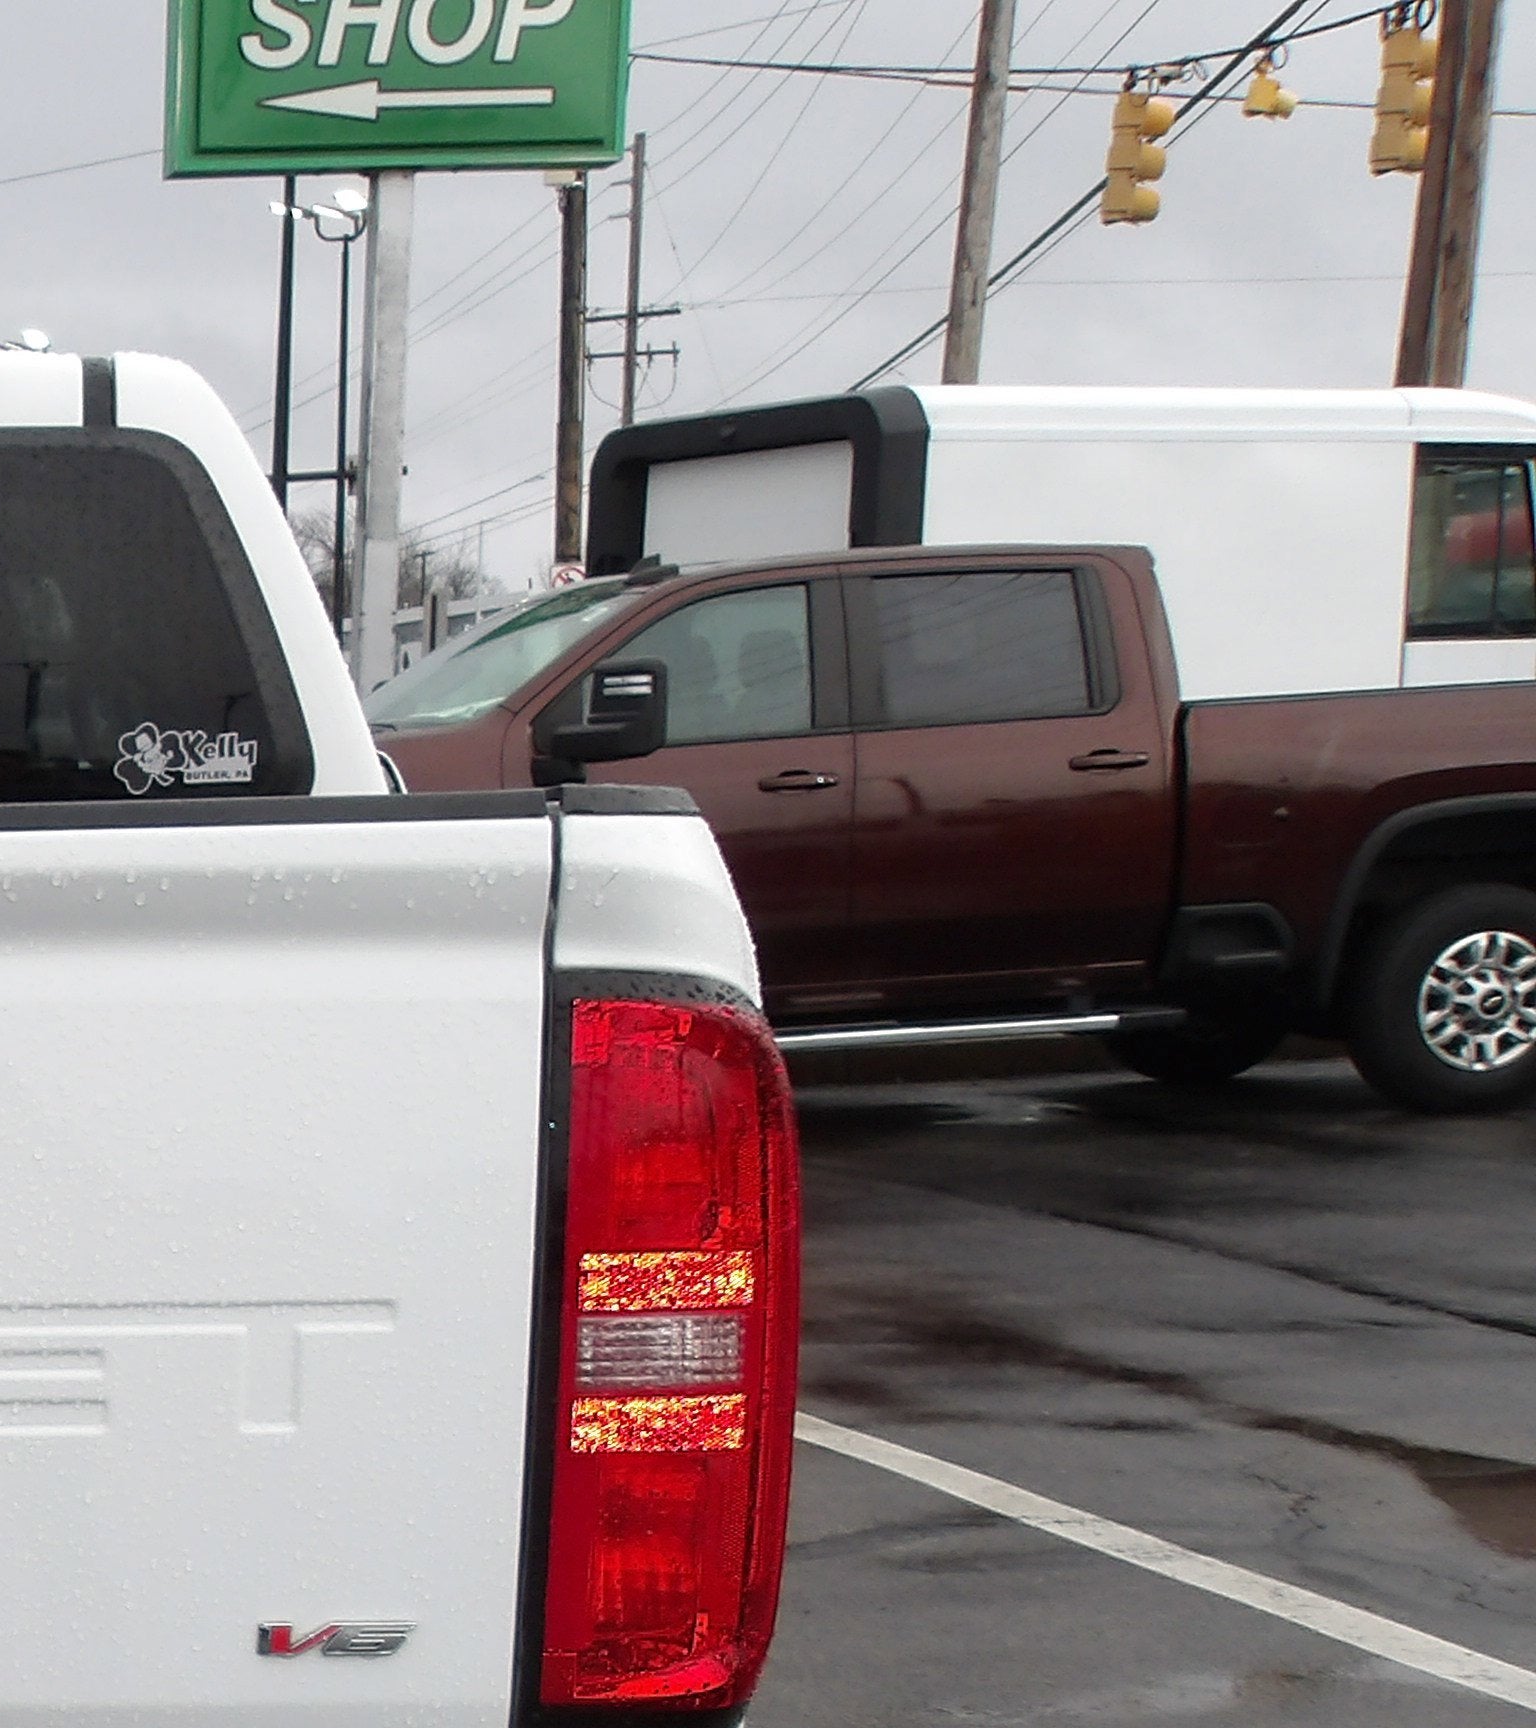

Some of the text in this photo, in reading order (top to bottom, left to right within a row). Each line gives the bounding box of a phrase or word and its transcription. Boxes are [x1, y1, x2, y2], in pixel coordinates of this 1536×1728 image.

[238, 0, 576, 70] SHOP
[180, 730, 257, 768] Kelly
[257, 1621, 418, 1656] V6
